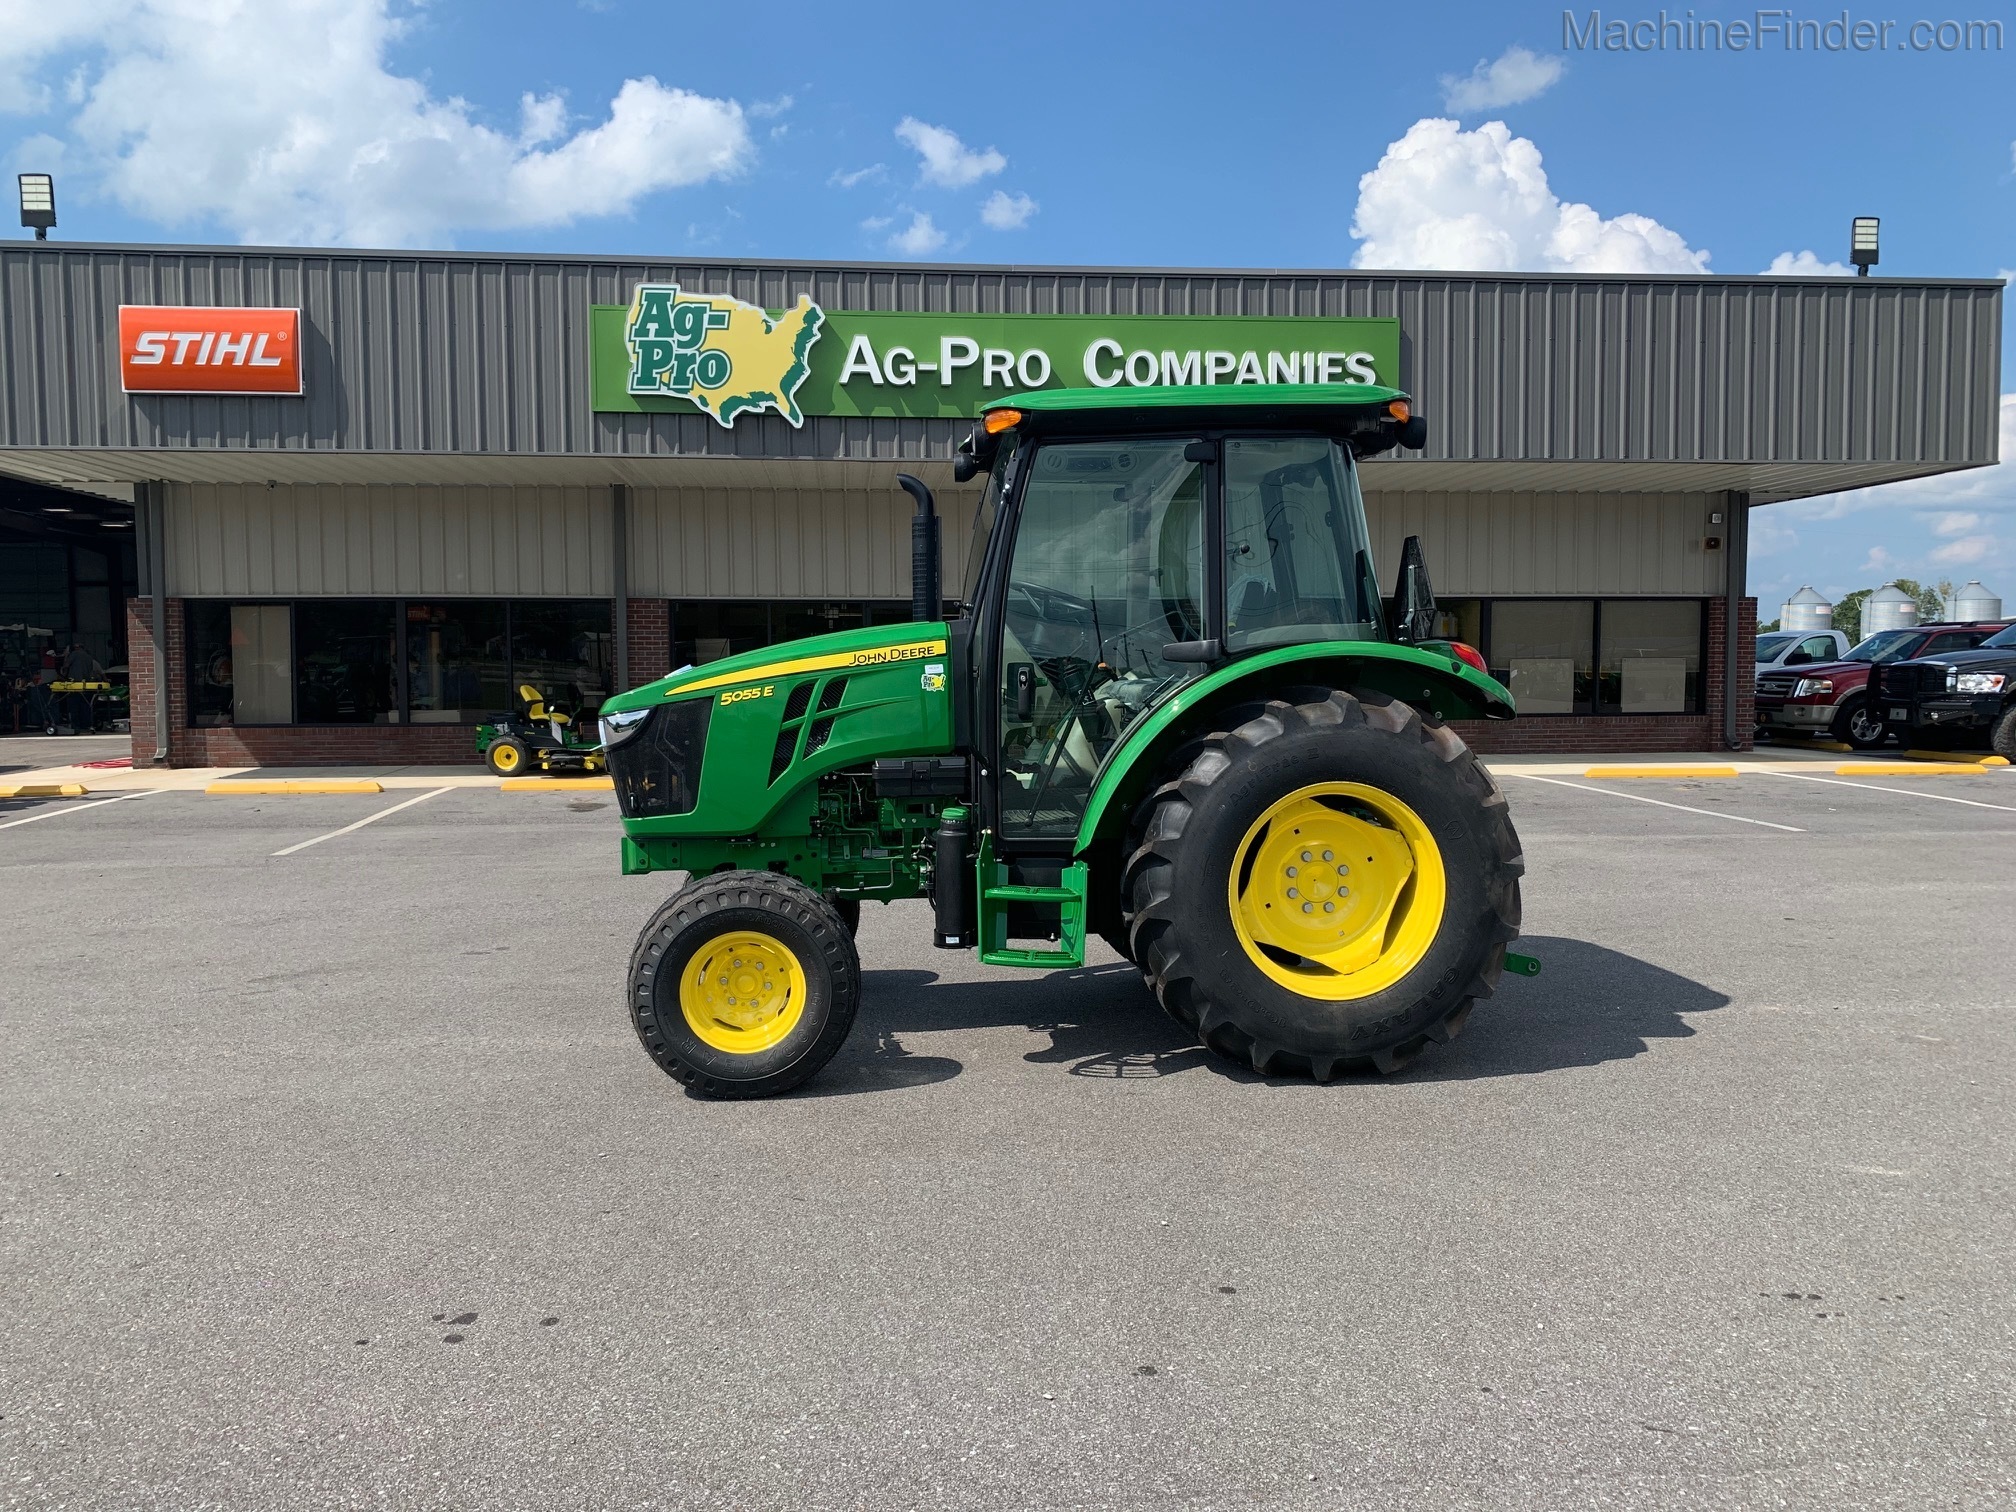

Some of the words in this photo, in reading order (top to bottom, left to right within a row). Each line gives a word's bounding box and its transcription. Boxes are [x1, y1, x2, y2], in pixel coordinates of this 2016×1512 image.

[629, 285, 731, 350] Ag-
[130, 331, 281, 366] STIHL
[629, 338, 733, 391] Pro
[838, 333, 1051, 388] AG-PRO
[1083, 337, 1377, 388] COMPANIES
[849, 652, 887, 665] JOHN
[890, 646, 935, 659] DEERE
[720, 687, 762, 706] 5055
[763, 685, 775, 697] E
